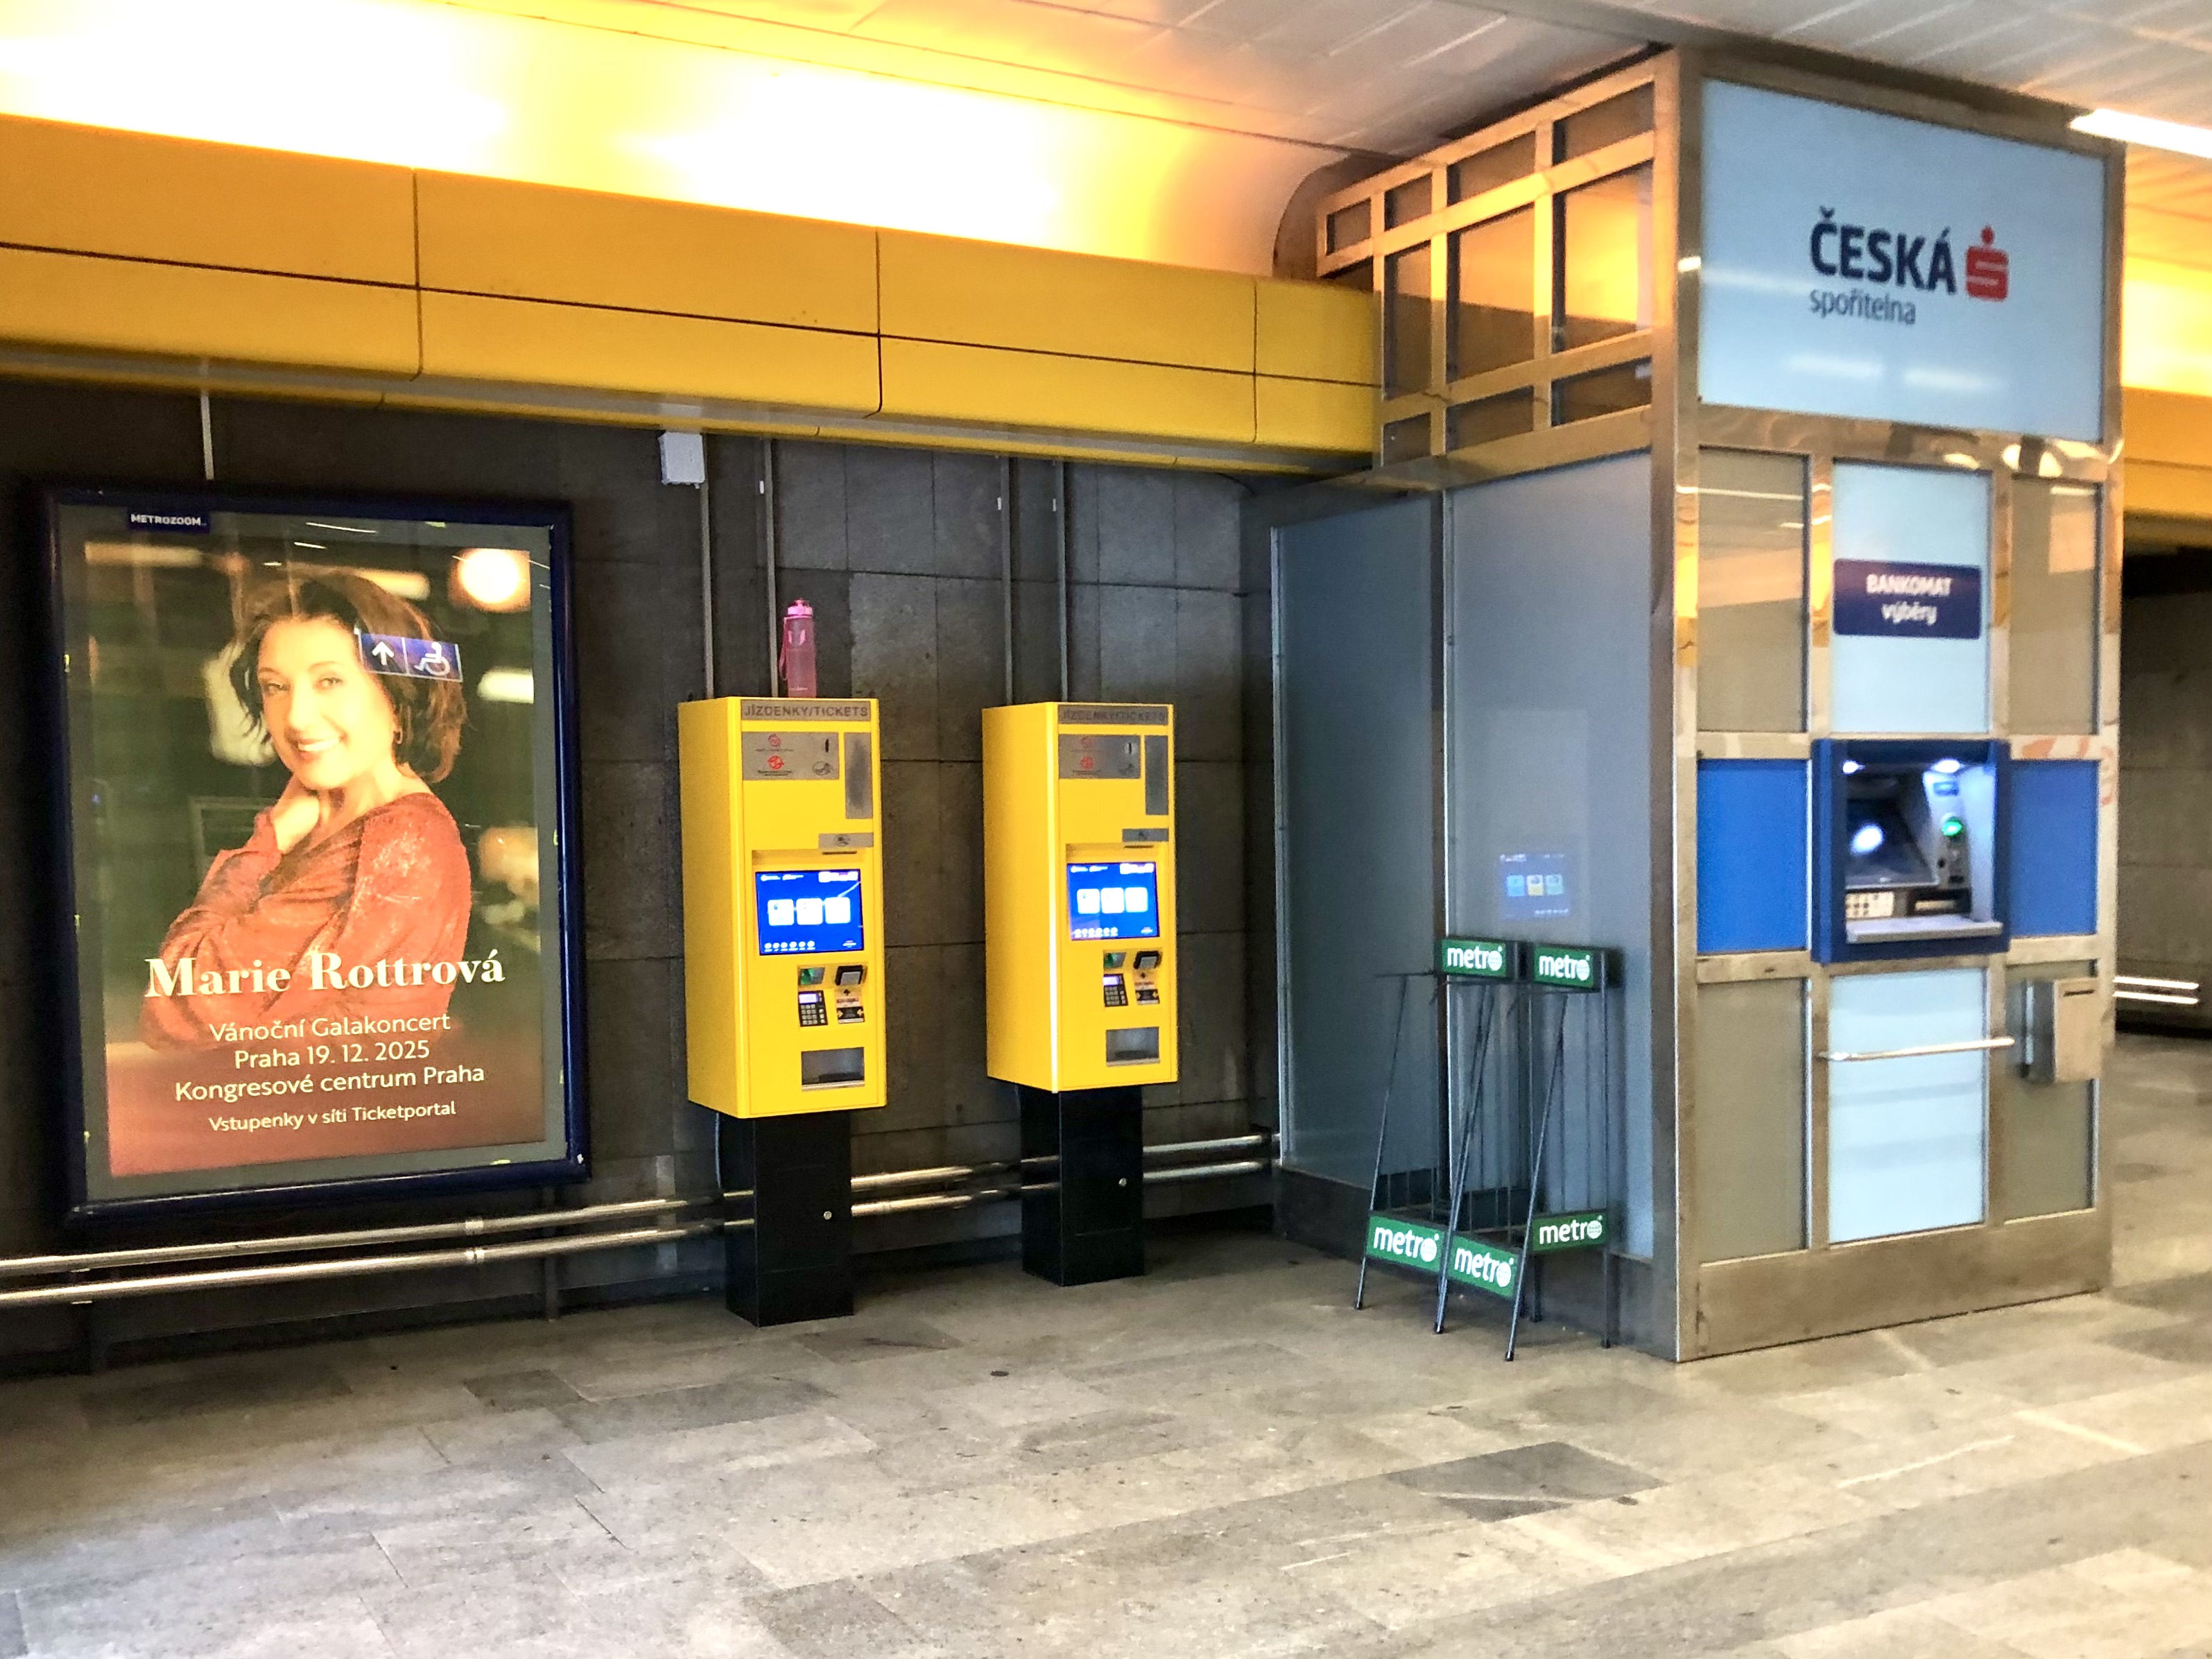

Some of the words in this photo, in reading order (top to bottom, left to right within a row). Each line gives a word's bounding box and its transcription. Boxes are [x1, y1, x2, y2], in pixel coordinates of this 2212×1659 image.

[1810, 206, 1958, 295] ČESKÁ
[1809, 288, 1917, 325] spořitelna
[130, 513, 201, 526] METROZOOM
[1866, 574, 1953, 596] BANKOMAT
[1446, 945, 1503, 971] metro
[1539, 954, 1591, 981] metro
[144, 956, 292, 999] Marie
[308, 949, 506, 991] Rottrová
[209, 1018, 306, 1042] Vánoční
[311, 1013, 451, 1038] Galakoncert
[234, 1047, 302, 1069] Praha
[306, 1045, 336, 1065] 19.
[342, 1043, 370, 1063] 12.
[374, 1040, 431, 1062] 2025
[175, 1072, 314, 1104] Kongresové
[320, 1069, 416, 1093] centrum
[424, 1065, 485, 1085] Praha
[209, 1111, 304, 1133] Vstupenky
[307, 1112, 318, 1125] v
[322, 1108, 347, 1124] síti
[351, 1101, 457, 1124] Ticketportal
[1373, 1226, 1440, 1263] metro
[1539, 1214, 1603, 1245] metro
[1454, 1246, 1514, 1288] metro
